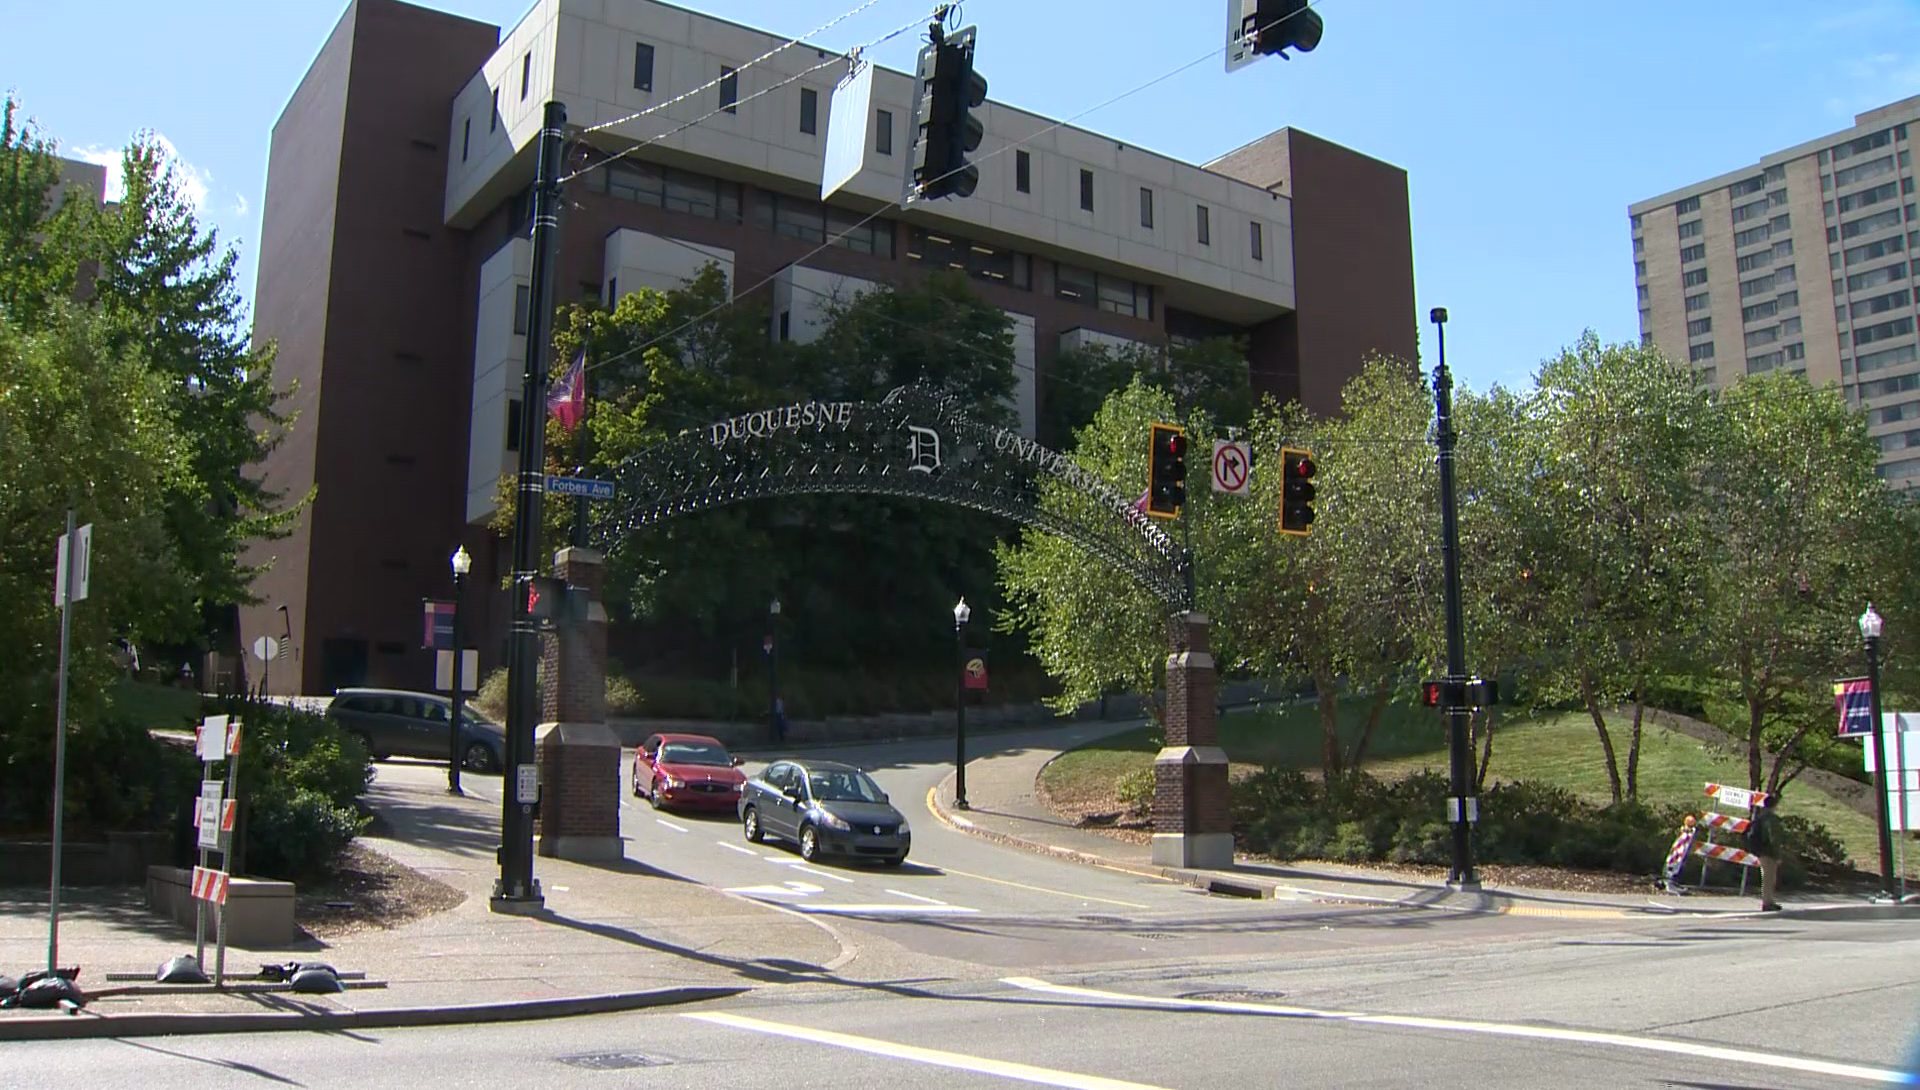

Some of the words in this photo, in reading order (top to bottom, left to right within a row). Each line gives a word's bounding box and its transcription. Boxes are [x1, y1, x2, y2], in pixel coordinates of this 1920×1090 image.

[712, 402, 853, 446] DUQUESNE
[907, 424, 942, 474] D
[552, 479, 588, 494] Forbes
[591, 483, 611, 496] Ave
